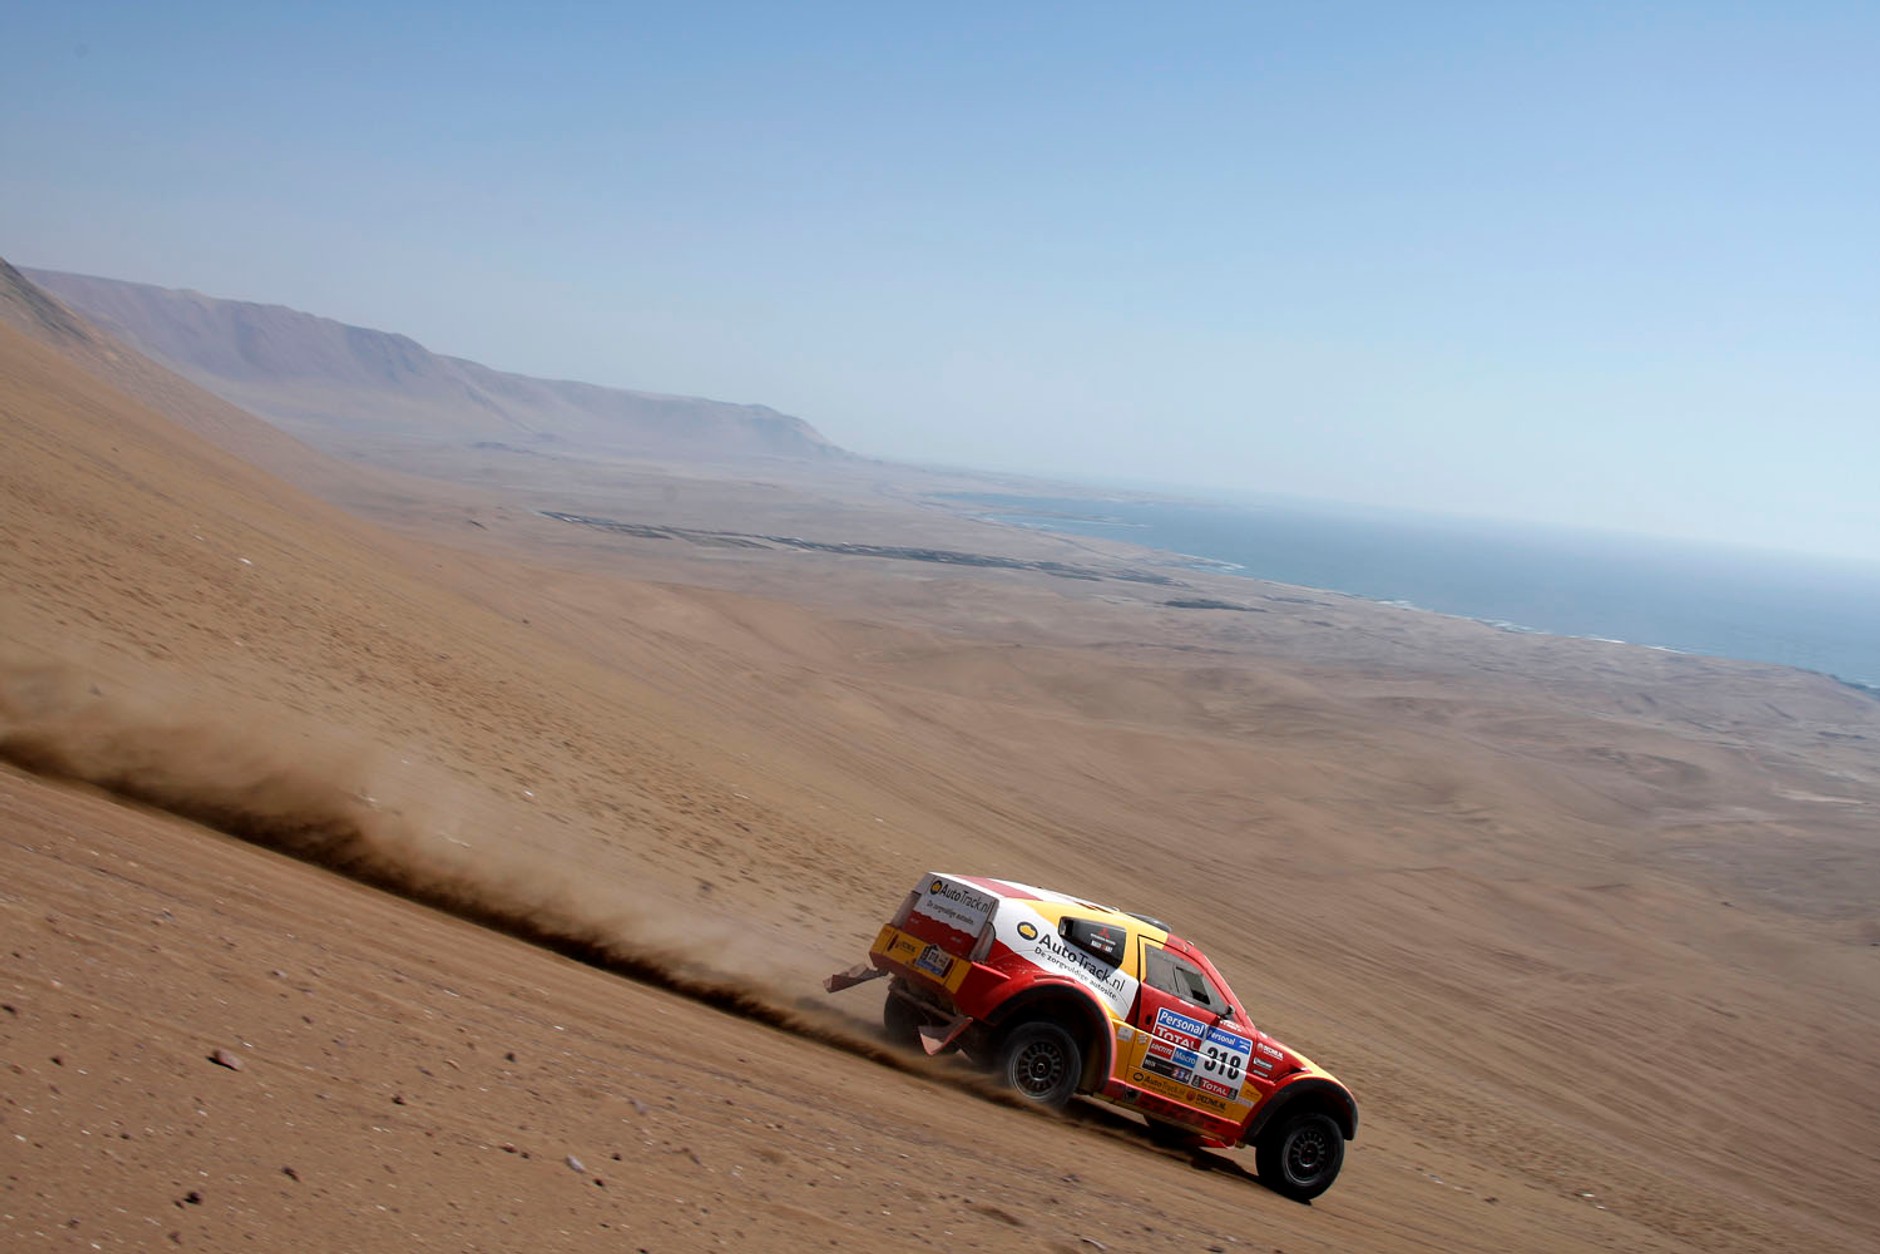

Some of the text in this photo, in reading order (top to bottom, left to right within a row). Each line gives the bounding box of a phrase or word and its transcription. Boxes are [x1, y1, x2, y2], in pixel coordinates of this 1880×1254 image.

[940, 884, 990, 913] AutoTrack.nl
[1034, 947, 1045, 957] De
[1047, 955, 1088, 981] zorgvuldige
[1039, 934, 1126, 992] AutoTrack.nl
[1160, 1011, 1204, 1035] Personal
[1208, 1029, 1236, 1046] Personal
[1175, 1051, 1196, 1065] Macro
[1204, 1047, 1240, 1080] 318
[1201, 1080, 1228, 1097] TOTAL
